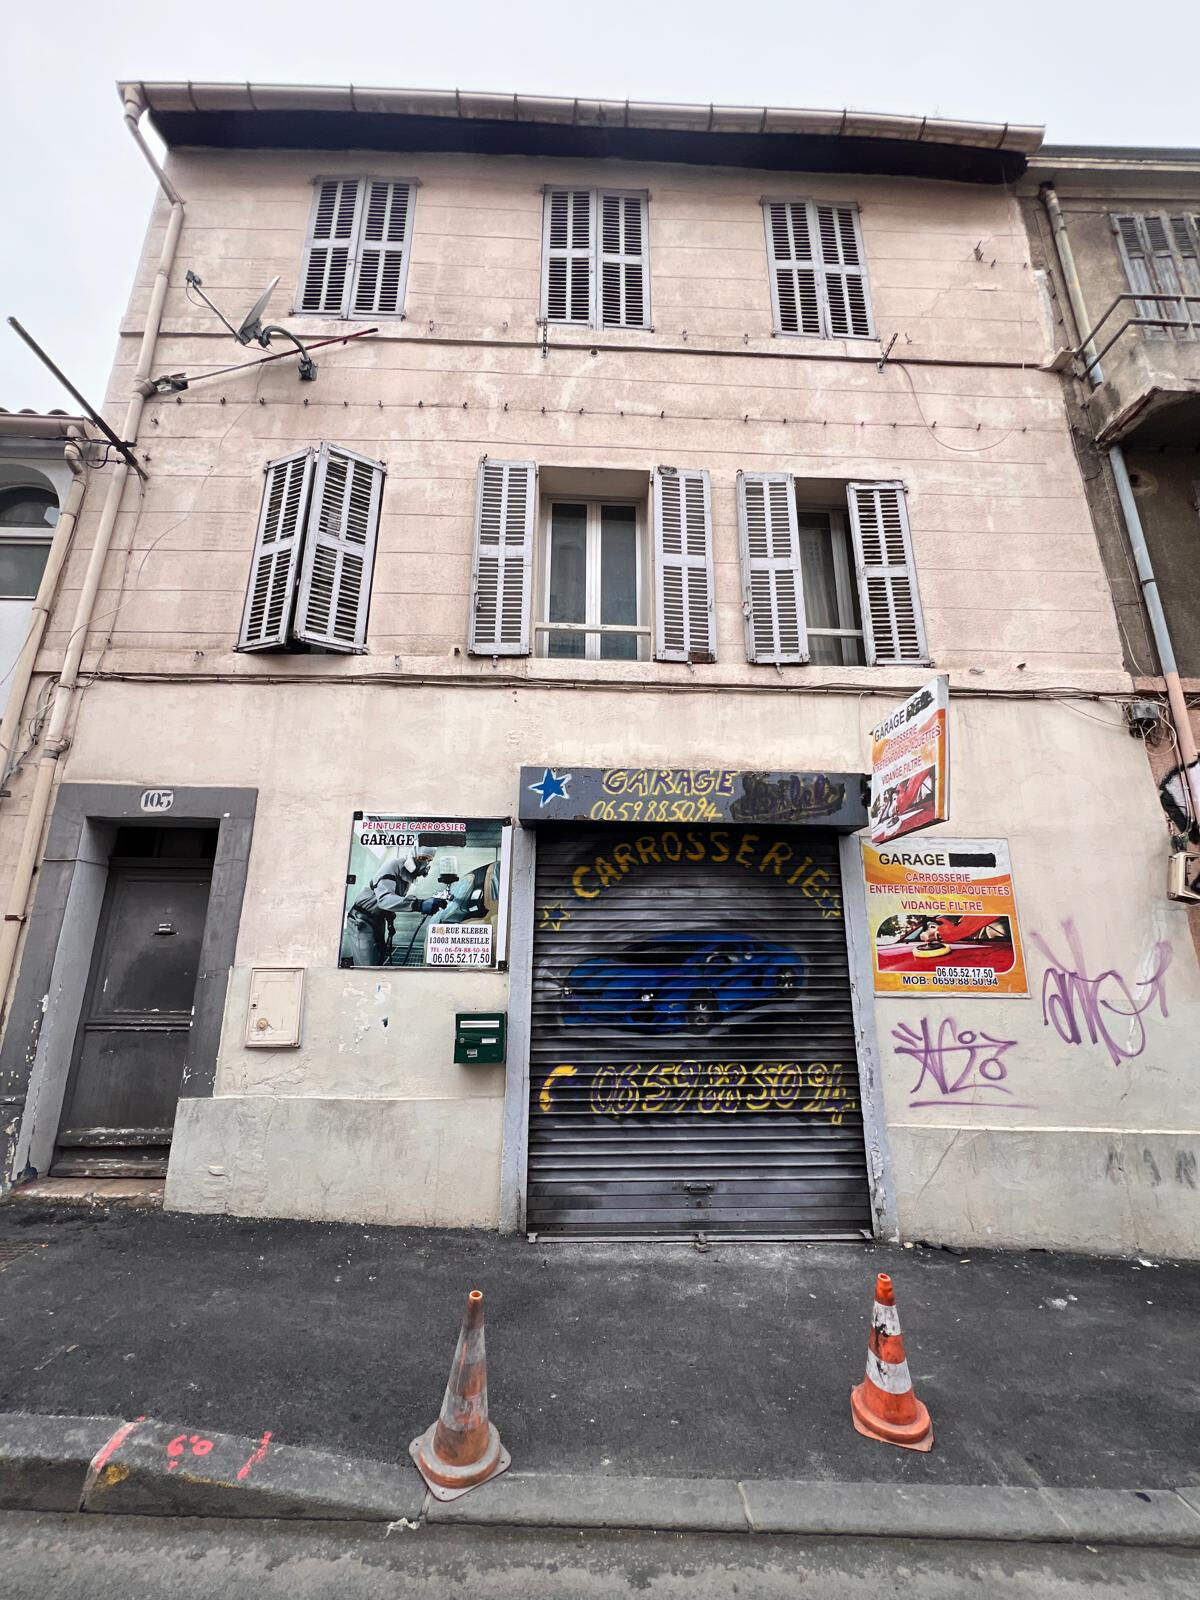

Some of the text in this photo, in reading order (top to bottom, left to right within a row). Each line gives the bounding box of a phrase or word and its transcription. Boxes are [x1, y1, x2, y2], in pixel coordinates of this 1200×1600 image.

[874, 709, 905, 742] GARAGE
[882, 755, 922, 785] VIDANGE FILTRE
[602, 769, 738, 796] GARAGE
[362, 821, 466, 831] PEINTURE CARROSSIER
[360, 834, 415, 846] GARAGE
[572, 831, 831, 898] CARROSSERIE
[879, 852, 946, 866] GARAGE
[905, 873, 971, 882] CARROSSERIE
[869, 885, 1010, 896] ENTRETIEN TOUS PLAQUETTES
[901, 901, 983, 911] VIDANGE FILTRE
[461, 927, 488, 935] KLEBER
[450, 937, 490, 945] MARSEILLE
[432, 953, 490, 964] 06.05.52.17.50
[936, 967, 993, 979] 06.05.52.17.50
[902, 976, 930, 985] MOB:
